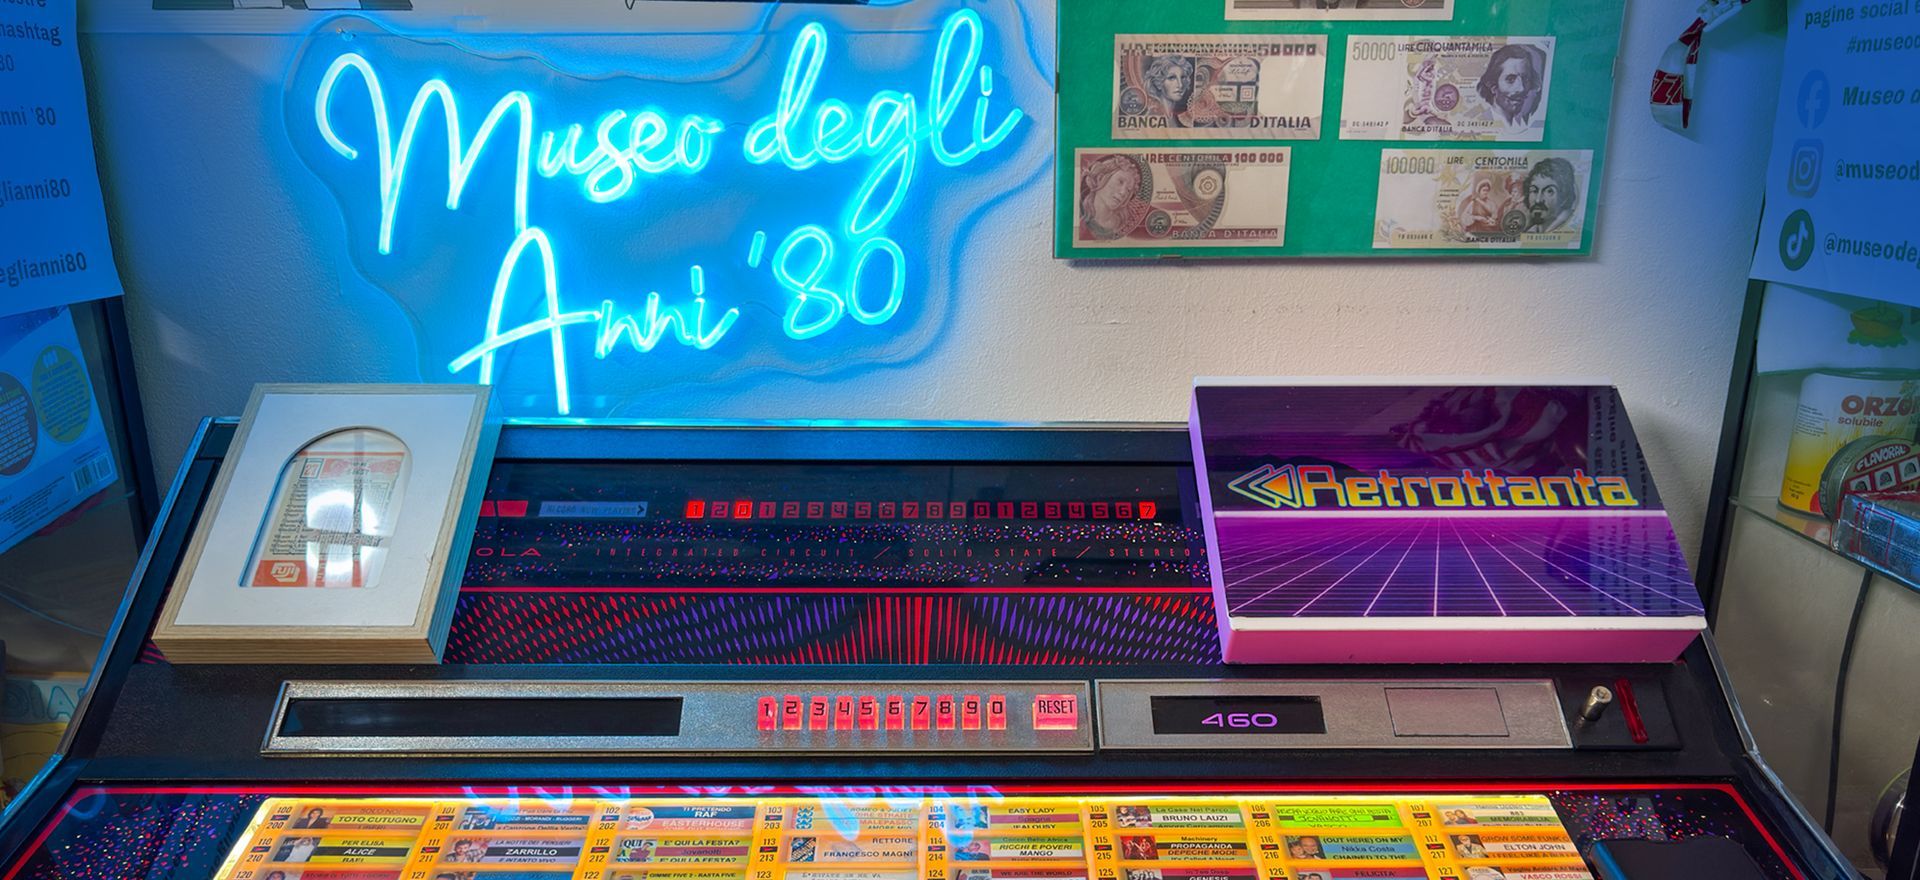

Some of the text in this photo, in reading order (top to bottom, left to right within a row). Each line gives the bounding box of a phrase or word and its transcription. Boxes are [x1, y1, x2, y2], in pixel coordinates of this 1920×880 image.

[1805, 0, 1908, 29] pagine social
[1352, 41, 1494, 61] 50000 LIRE CINQUANTAMILA
[1843, 86, 1904, 106] Museo
[0, 107, 27, 126] nni
[1118, 116, 1311, 128] BANCA D'ITALIA
[315, 9, 1024, 254] Museo degli
[1140, 153, 1164, 163] LIRE
[1168, 154, 1230, 163] CENTOMILA
[1447, 156, 1464, 165] LIRE
[1475, 156, 1528, 166] CENTOMILA
[1171, 229, 1278, 239] BANCA D'ITALIA
[447, 226, 906, 415] Anni '80
[1837, 415, 1884, 428] solubile
[1298, 465, 1639, 508] Retrottanta
[475, 547, 542, 557] OLA
[595, 548, 740, 557] INTEGRATED
[760, 548, 855, 557] CIRCUIT
[908, 549, 973, 557] SOLID
[994, 549, 1058, 557] STATE
[1038, 700, 1074, 715] RESET
[1200, 712, 1278, 728] 460
[367, 816, 417, 824] CUTUGNO
[662, 820, 745, 828] EASTERHOUSE
[344, 848, 375, 856] ALICE
[505, 848, 558, 856] ZARRILLO
